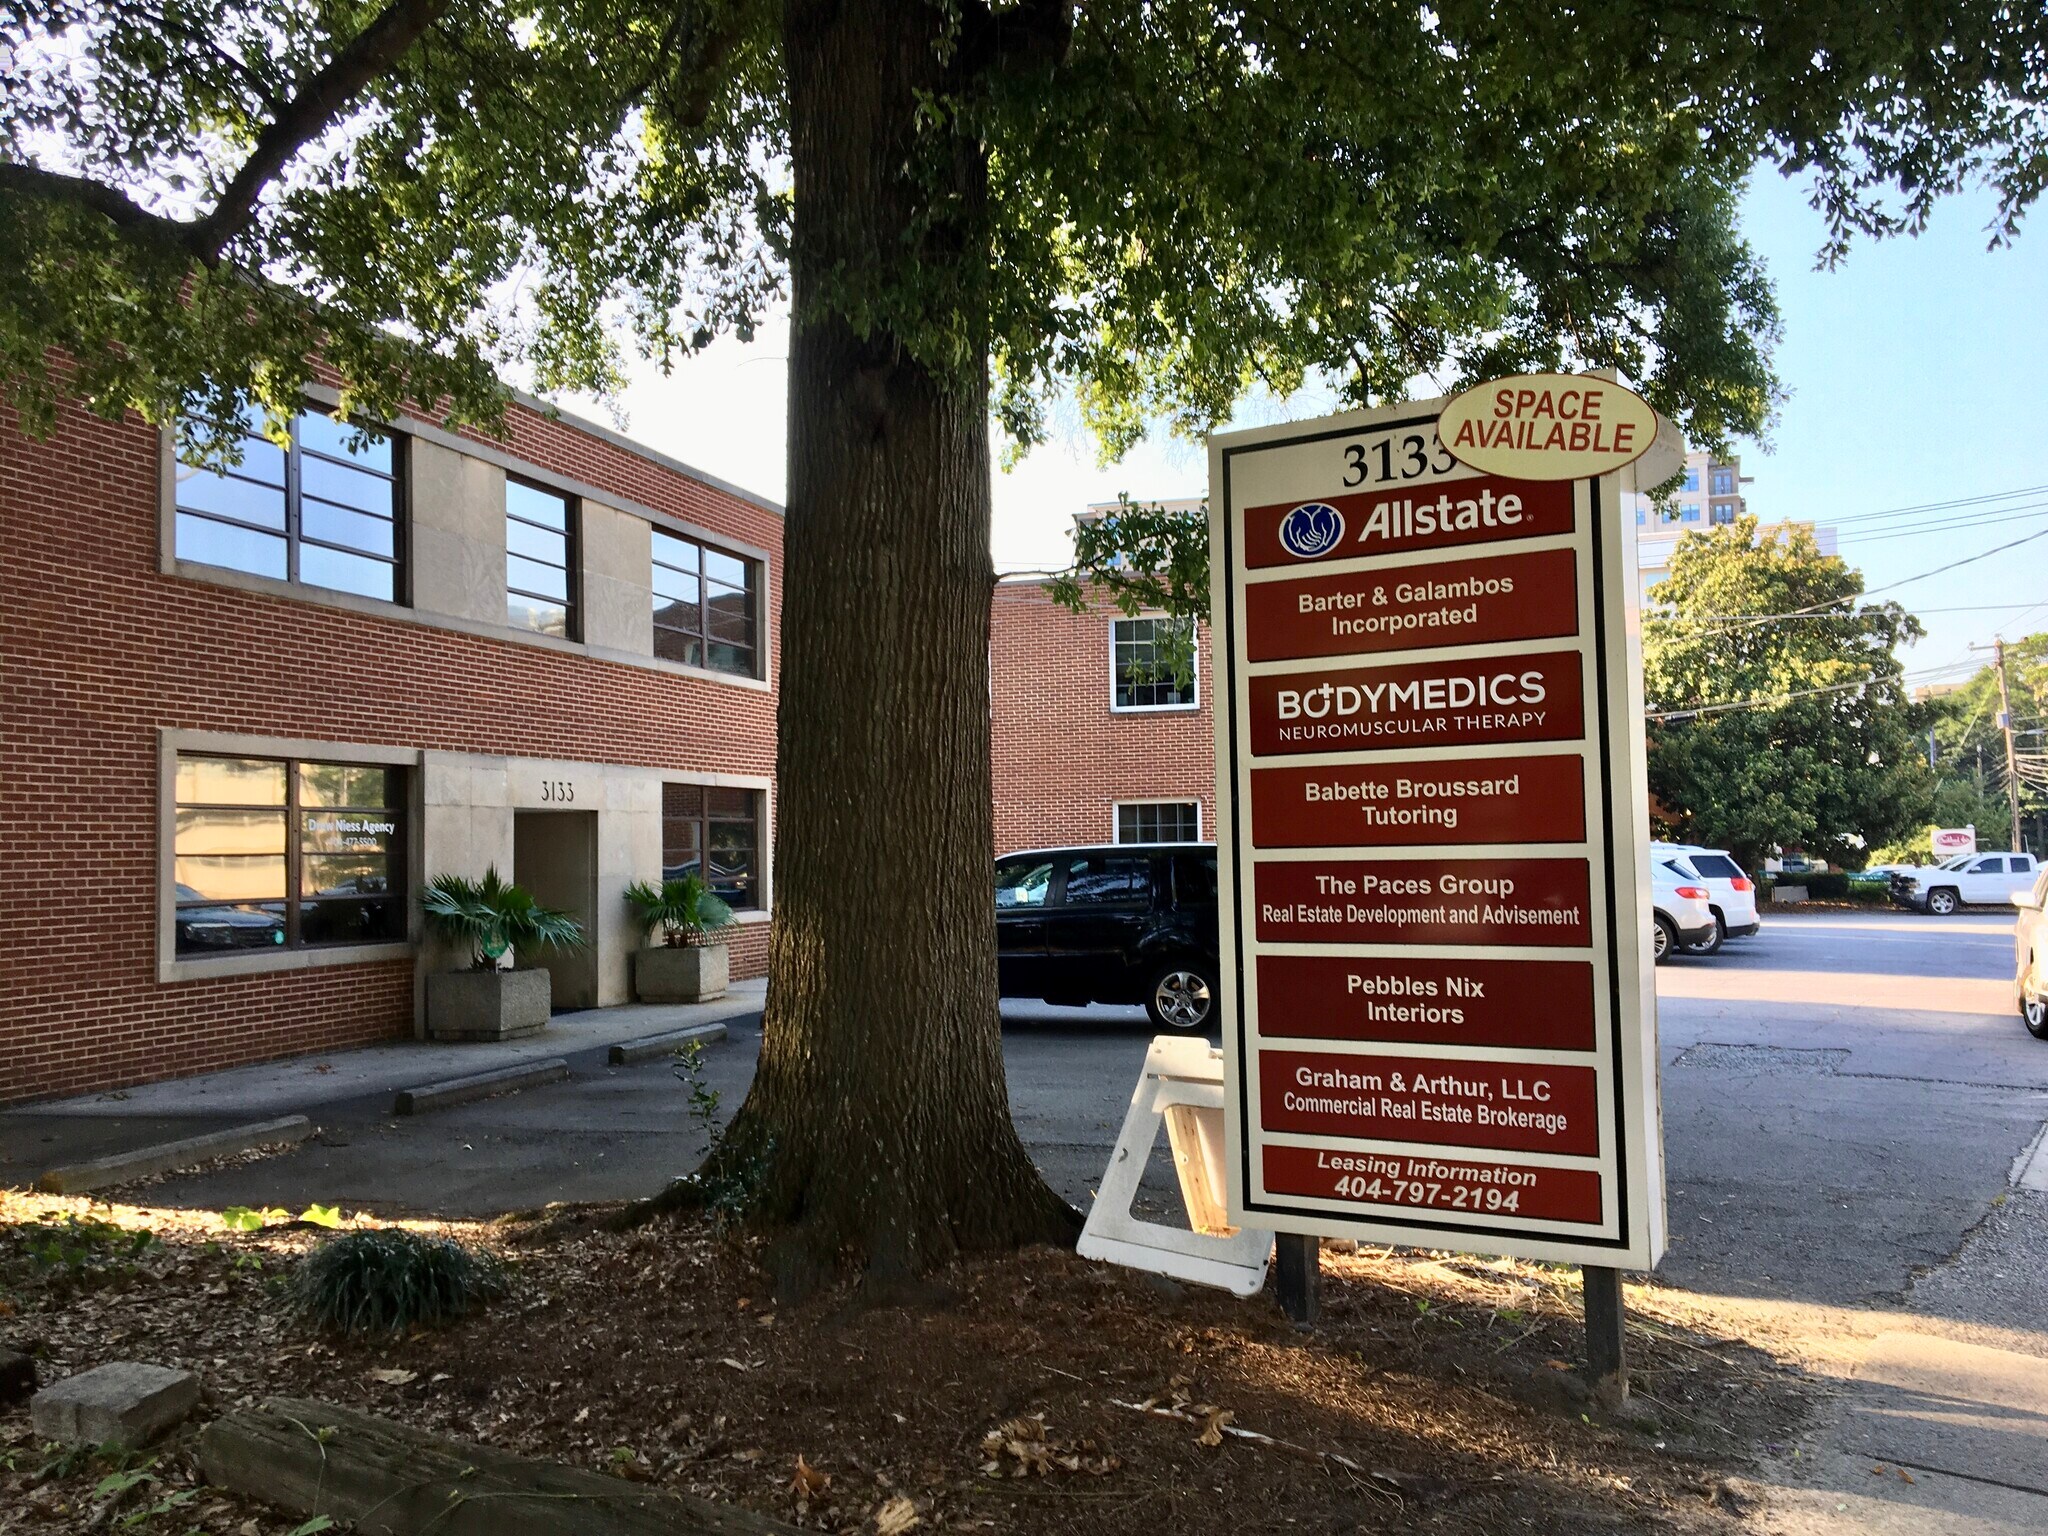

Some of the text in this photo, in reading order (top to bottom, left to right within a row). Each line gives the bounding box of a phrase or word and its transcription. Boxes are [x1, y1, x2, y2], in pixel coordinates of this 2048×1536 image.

[1494, 390, 1603, 421] SPACE
[1453, 420, 1635, 453] AVAILABLE
[1342, 435, 1458, 487] 3133
[1358, 489, 1523, 543] Allstate
[1298, 577, 1514, 614] Barter & Galambos
[1332, 604, 1478, 636] Incorporated
[1278, 671, 1546, 720] BODYMEDICS
[1279, 711, 1547, 741] NEUROMUSCULAR THERAPY
[541, 781, 574, 802] 3133
[1305, 774, 1520, 802] Babette Broussard
[335, 819, 361, 832] Niess
[362, 819, 395, 836] Agency
[1363, 803, 1458, 828] Tutoring
[1316, 874, 1514, 899] The Paces Group
[1263, 905, 1579, 928] Real Estate Development and Advisement
[1347, 975, 1485, 998] Pebbles Nix
[1367, 1002, 1465, 1023] Interiors
[1295, 1068, 1551, 1101] Graham & Arthur, LLC
[1284, 1092, 1567, 1135] Commercial Real Estate Brokerage
[1317, 1152, 1537, 1187] Leasing Information
[1334, 1176, 1520, 1212] 404-797-2194
